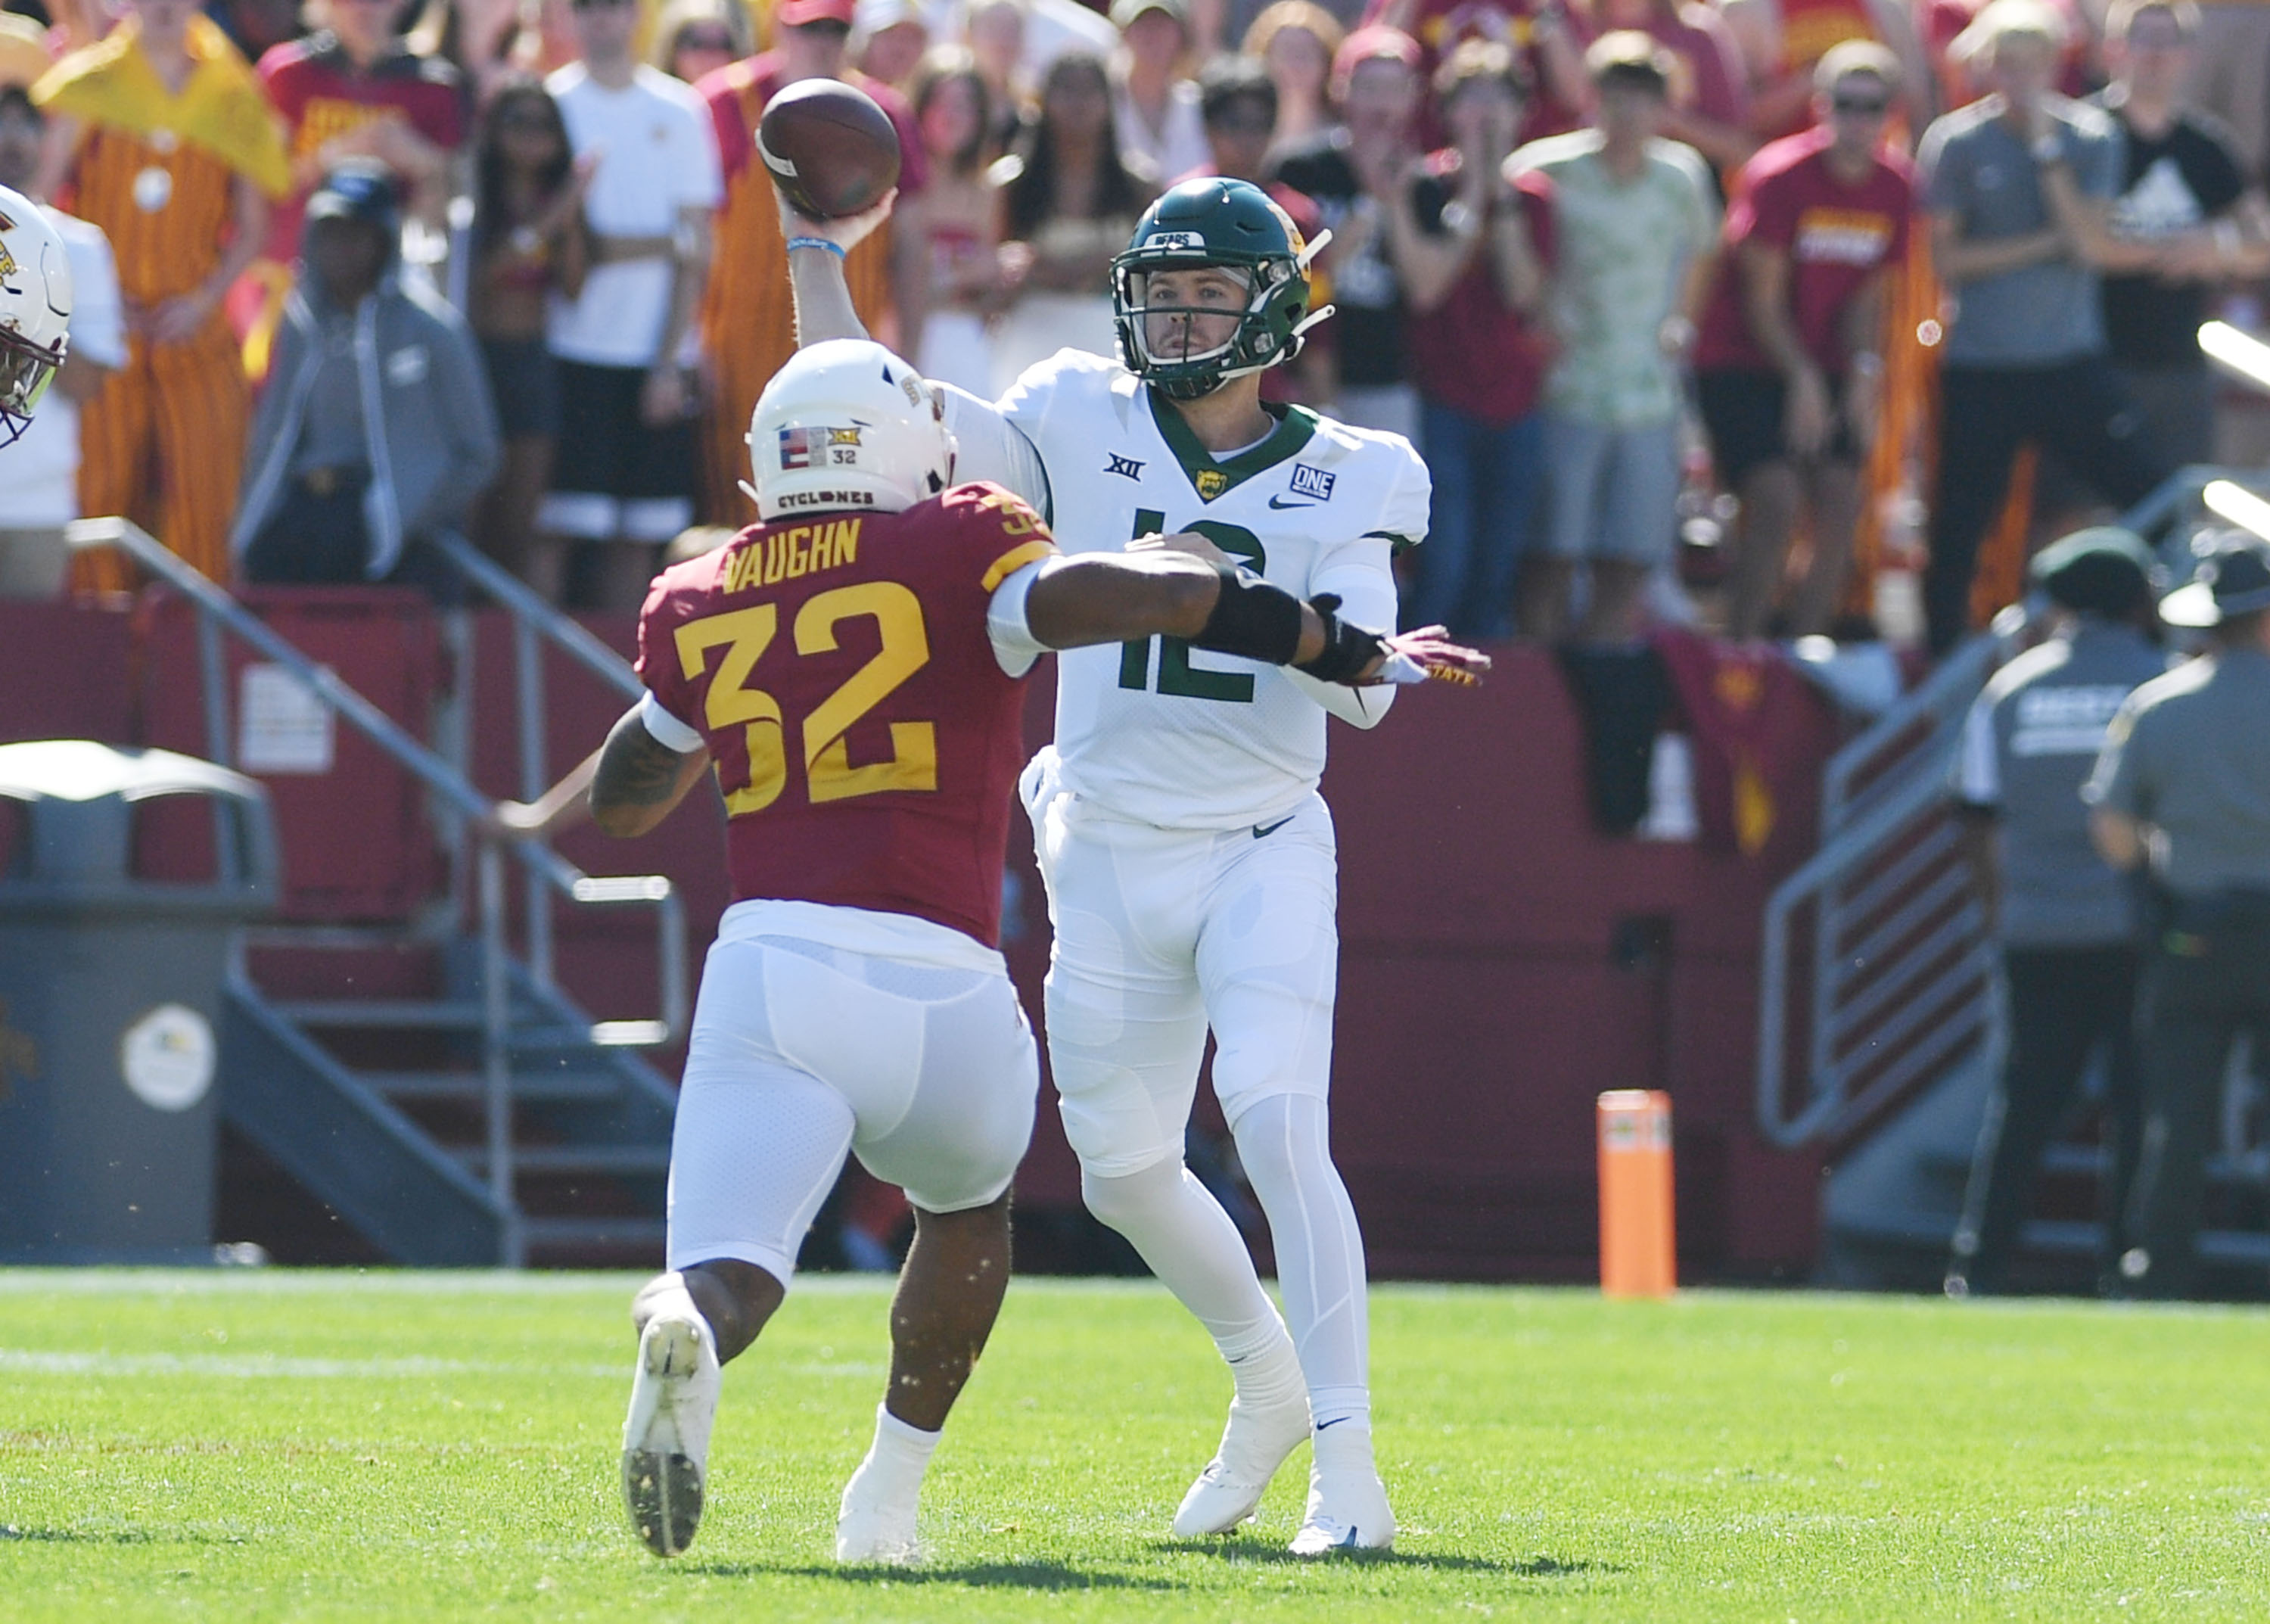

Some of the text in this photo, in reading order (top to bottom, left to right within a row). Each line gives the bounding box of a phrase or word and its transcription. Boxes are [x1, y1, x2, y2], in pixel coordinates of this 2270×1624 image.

[832, 450, 857, 465] 32
[1102, 452, 1146, 483] XII
[1295, 466, 1333, 493] ONE
[723, 518, 861, 595] VAUGHN
[673, 580, 938, 819] 32
